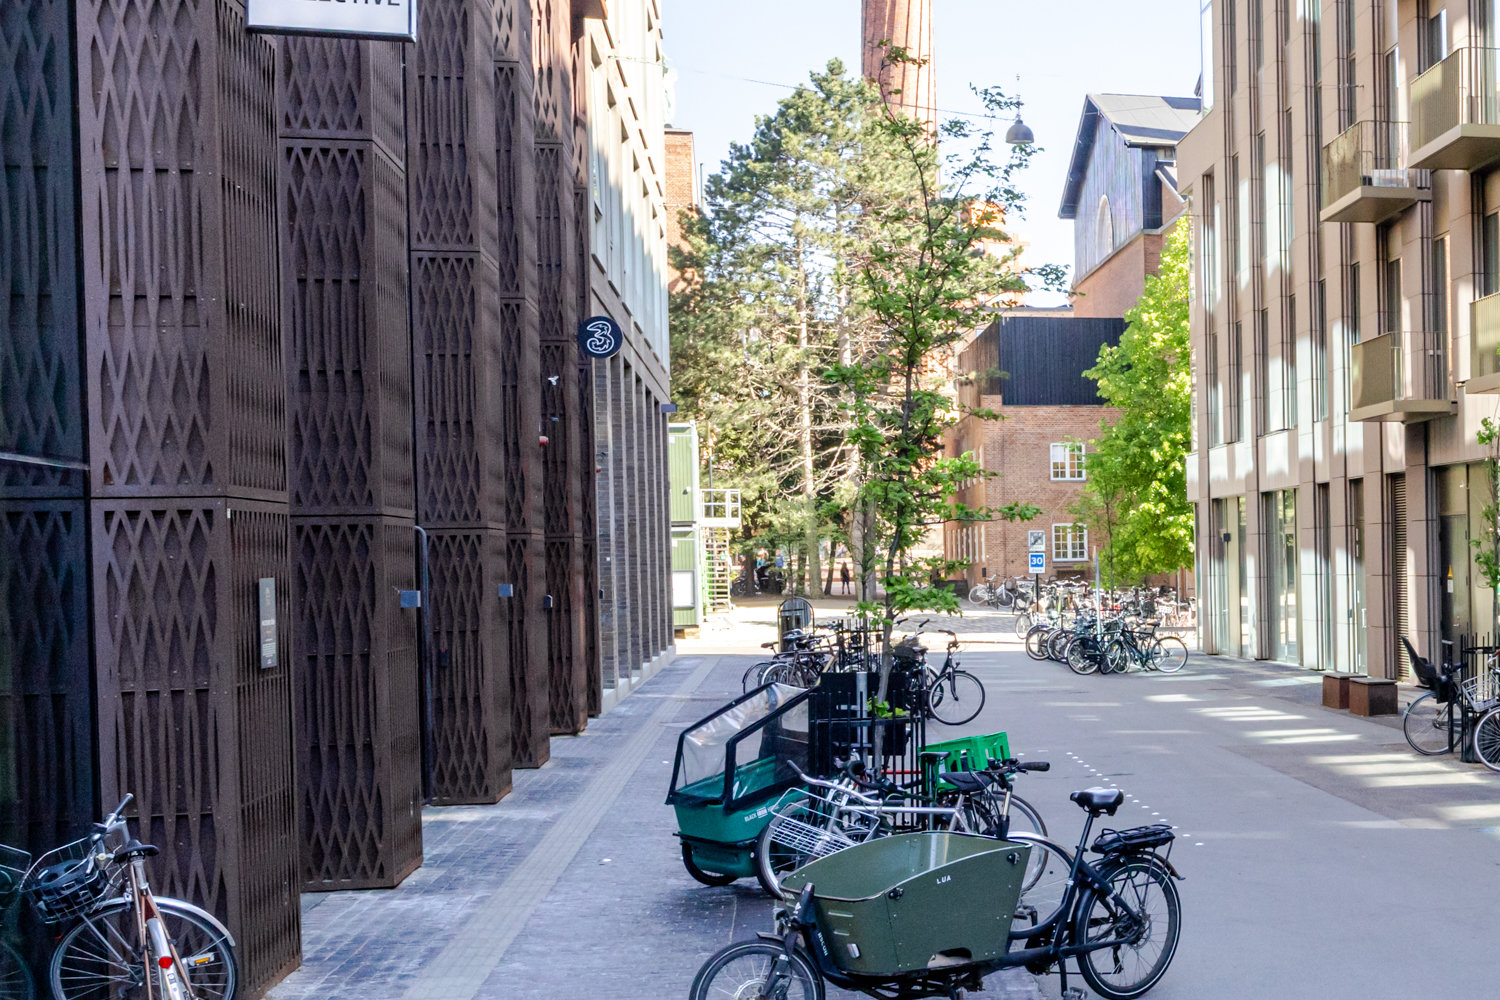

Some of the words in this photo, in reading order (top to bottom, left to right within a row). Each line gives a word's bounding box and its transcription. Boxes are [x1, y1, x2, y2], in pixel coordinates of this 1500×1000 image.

[586, 321, 615, 354] 3
[1031, 557, 1043, 565] 30
[936, 875, 951, 884] LUA
